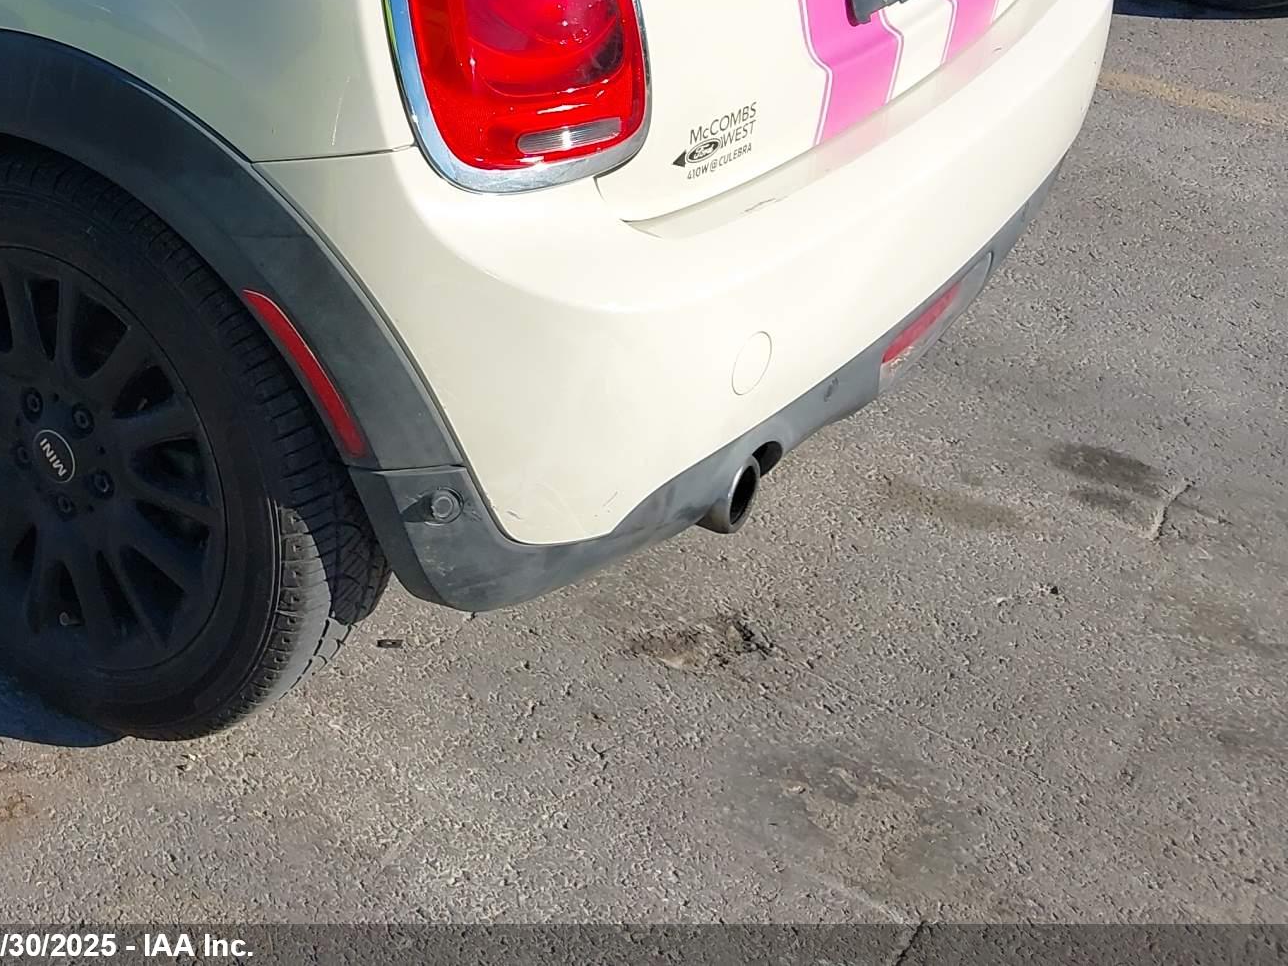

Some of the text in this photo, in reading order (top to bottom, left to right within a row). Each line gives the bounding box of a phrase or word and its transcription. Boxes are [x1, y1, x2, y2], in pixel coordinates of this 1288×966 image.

[689, 101, 757, 145] McCOMBS
[722, 119, 757, 149] WEST
[39, 437, 68, 477] MINI
